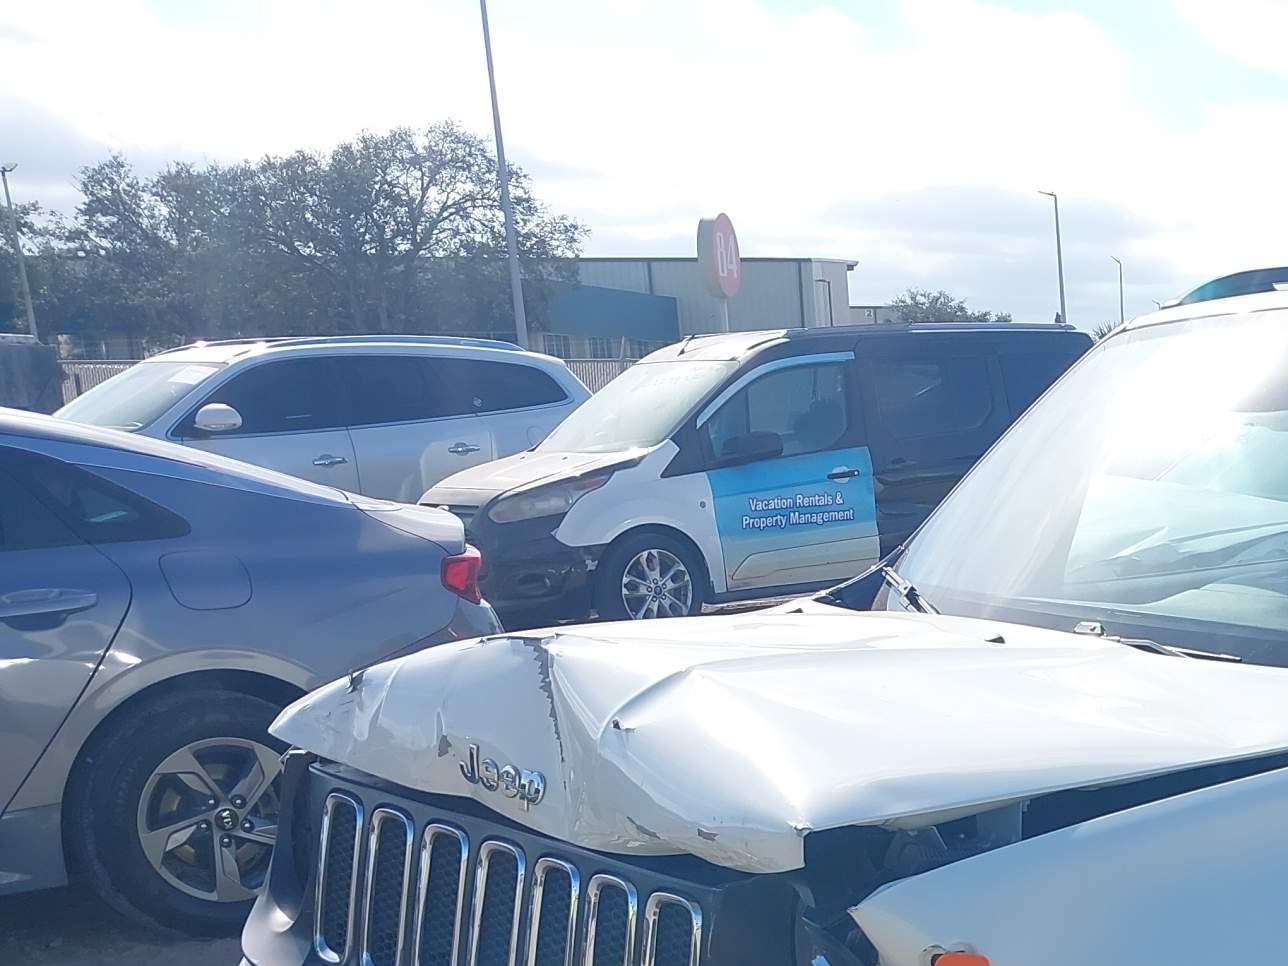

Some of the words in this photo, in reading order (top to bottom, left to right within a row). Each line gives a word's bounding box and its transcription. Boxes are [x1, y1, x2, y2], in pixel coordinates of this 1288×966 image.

[749, 497, 793, 511] Vacation
[796, 493, 833, 508] Rentals
[835, 491, 844, 505] &
[742, 514, 787, 530] Property
[790, 509, 855, 525] Management
[458, 743, 547, 812] Jeep
